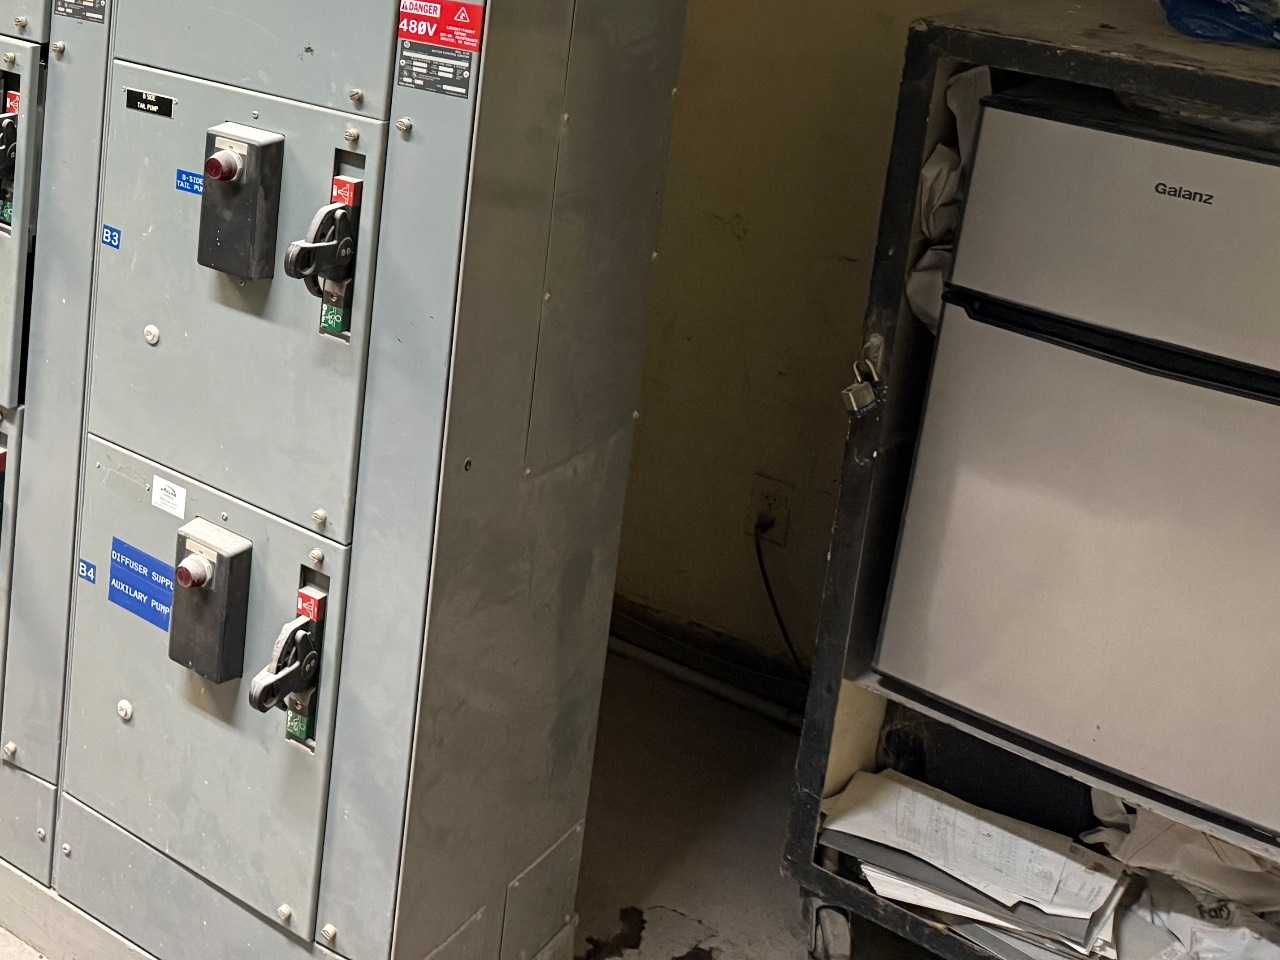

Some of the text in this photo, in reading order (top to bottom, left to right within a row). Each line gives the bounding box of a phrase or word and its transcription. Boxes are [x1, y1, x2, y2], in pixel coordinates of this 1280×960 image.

[408, 1, 438, 15] DANGER
[177, 181, 190, 190] TAIL
[1155, 182, 1215, 205] Galanz
[104, 229, 119, 246] B3
[111, 550, 148, 576] DIFFUSER
[79, 564, 95, 581] B4
[111, 578, 170, 615] AUXILARY PUMP
